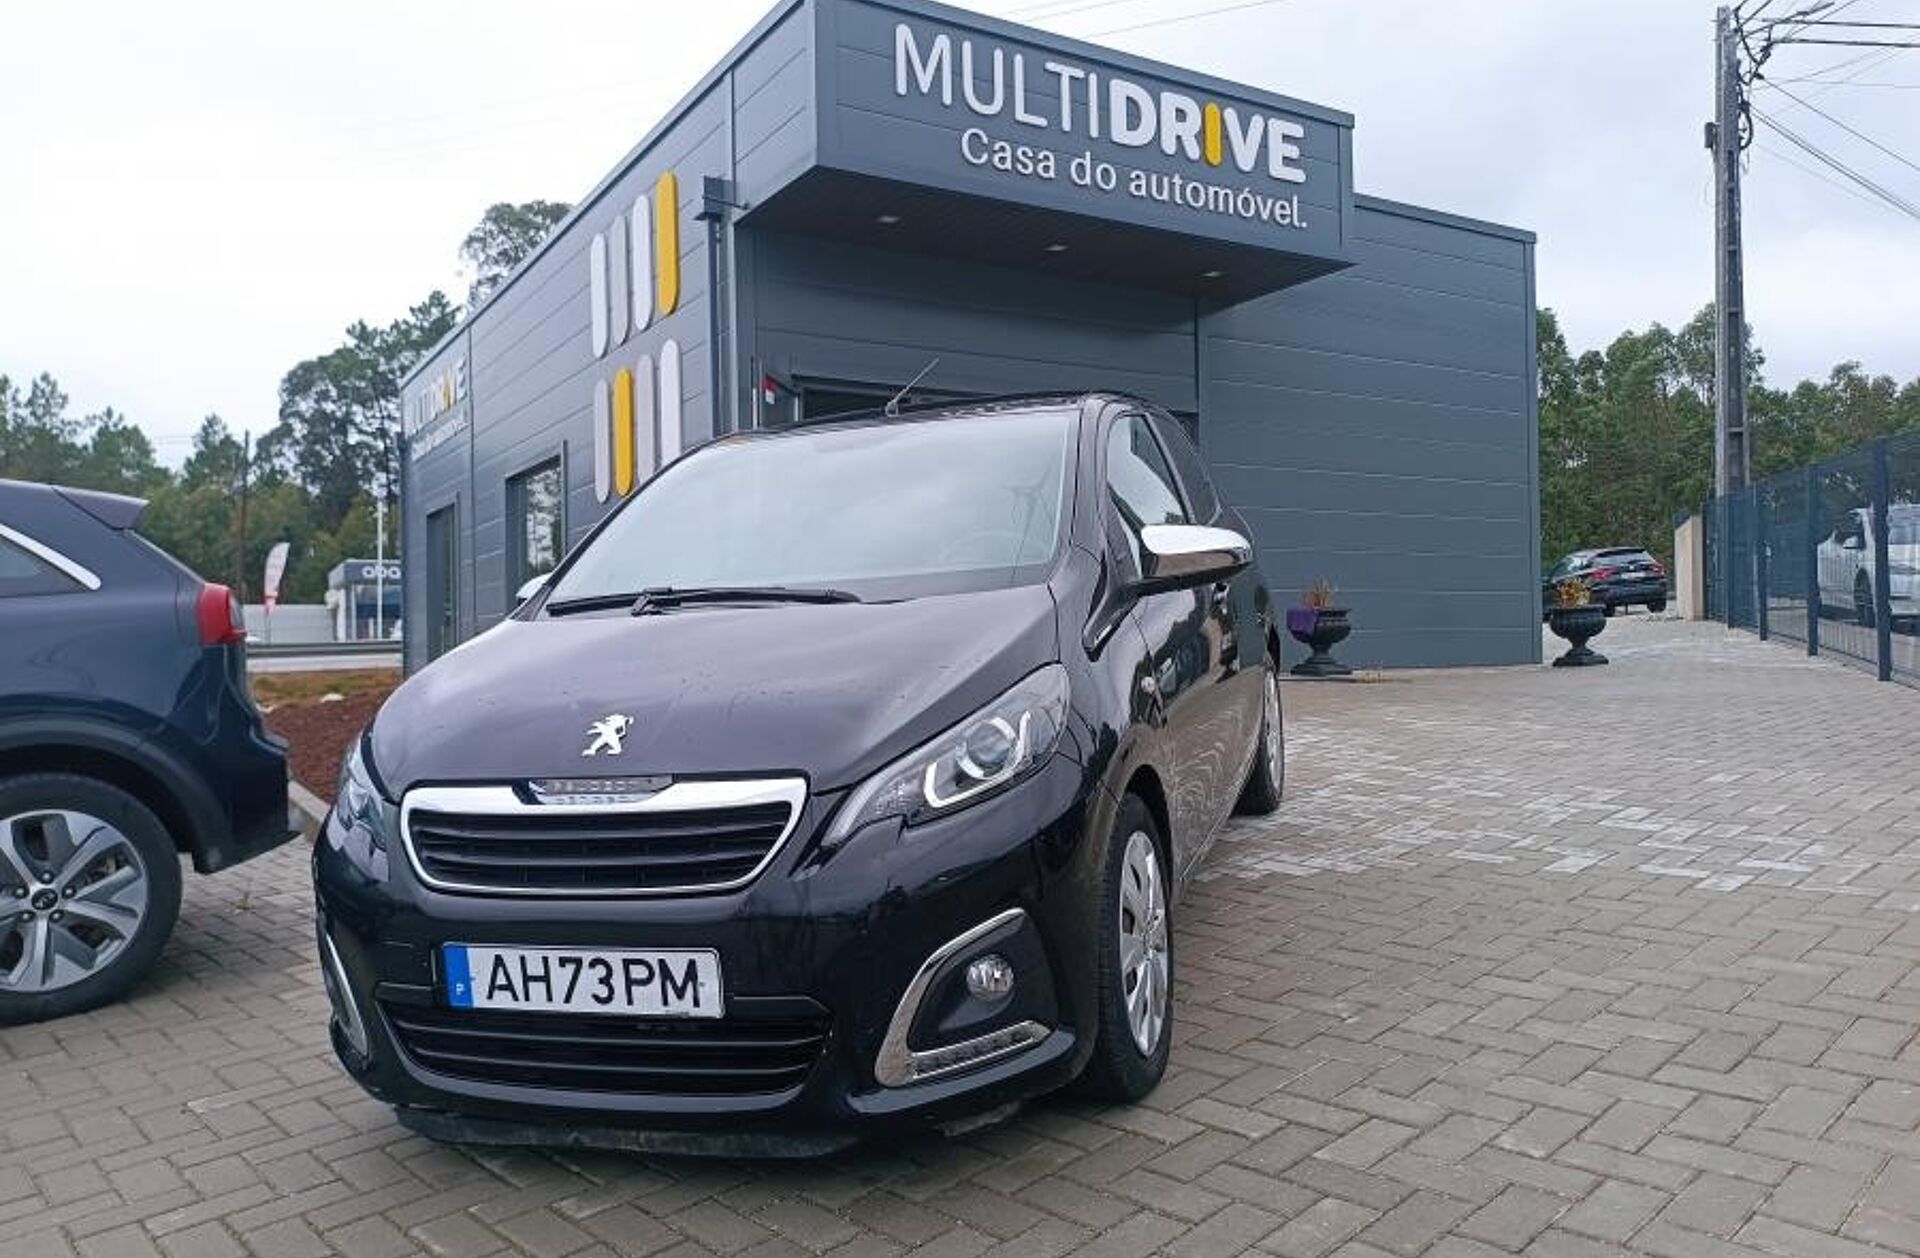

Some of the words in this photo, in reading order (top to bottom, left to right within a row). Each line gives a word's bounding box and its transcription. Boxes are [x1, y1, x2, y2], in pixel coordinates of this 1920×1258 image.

[894, 23, 1307, 183] MULTIDRIVE
[960, 128, 1057, 180] Casa
[1070, 151, 1118, 191] do
[1129, 168, 1308, 229] automóvel.
[486, 953, 701, 1008] AH73PM
